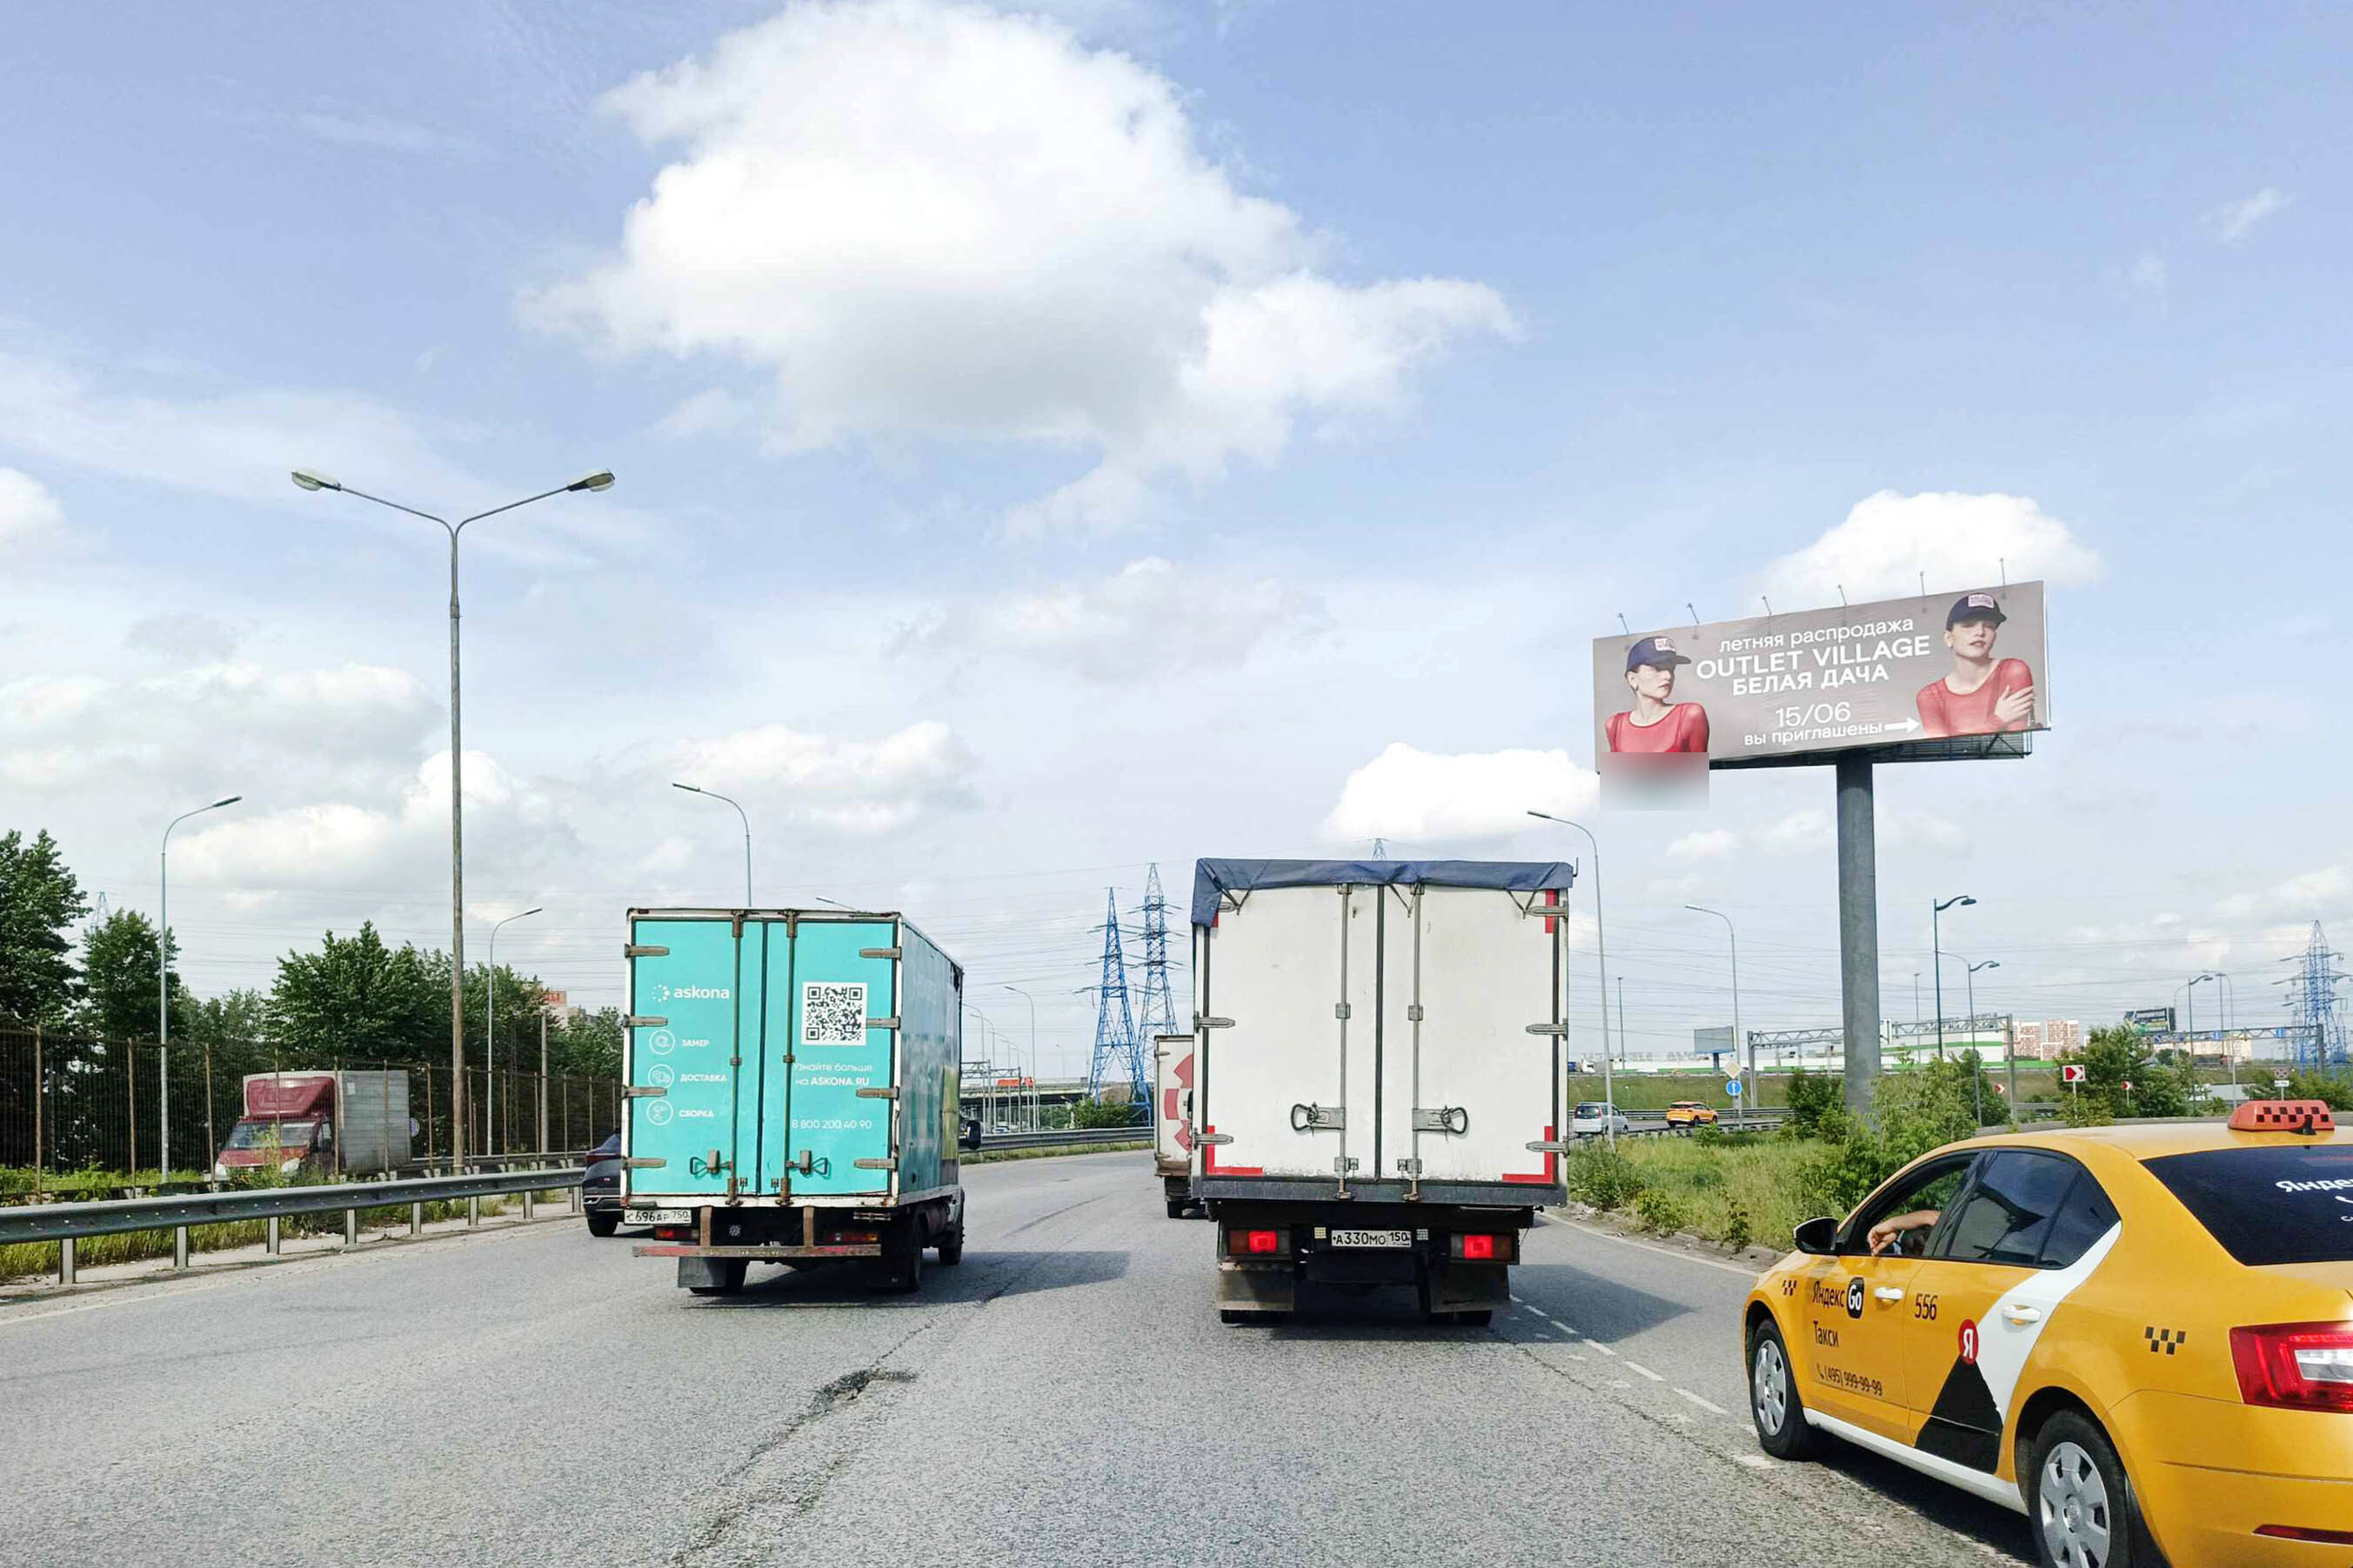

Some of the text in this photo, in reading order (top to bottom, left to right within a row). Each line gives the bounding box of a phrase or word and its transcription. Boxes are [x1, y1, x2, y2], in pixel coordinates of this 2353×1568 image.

[1720, 618, 1914, 652] летняя распродажа
[1696, 636, 1930, 679] OUTLET VILLAGE
[1733, 664, 1888, 696] БЕЛАЯ ДАЧА
[1775, 702, 1851, 728] 15/06
[1744, 723, 1882, 745] вы приглашены
[673, 984, 730, 1000] askona
[681, 1073, 726, 1083] ДОСТАВКА
[792, 1062, 873, 1072] Узнайте больше
[792, 1119, 873, 1129] 8 800 200 40 90
[1812, 1280, 1862, 1311] Яндекс Go
[1915, 1293, 1938, 1321] 556
[1813, 1320, 1839, 1348] Такси
[1962, 1328, 1974, 1358] Я
[1824, 1364, 1883, 1397] (495) 999-99-99
